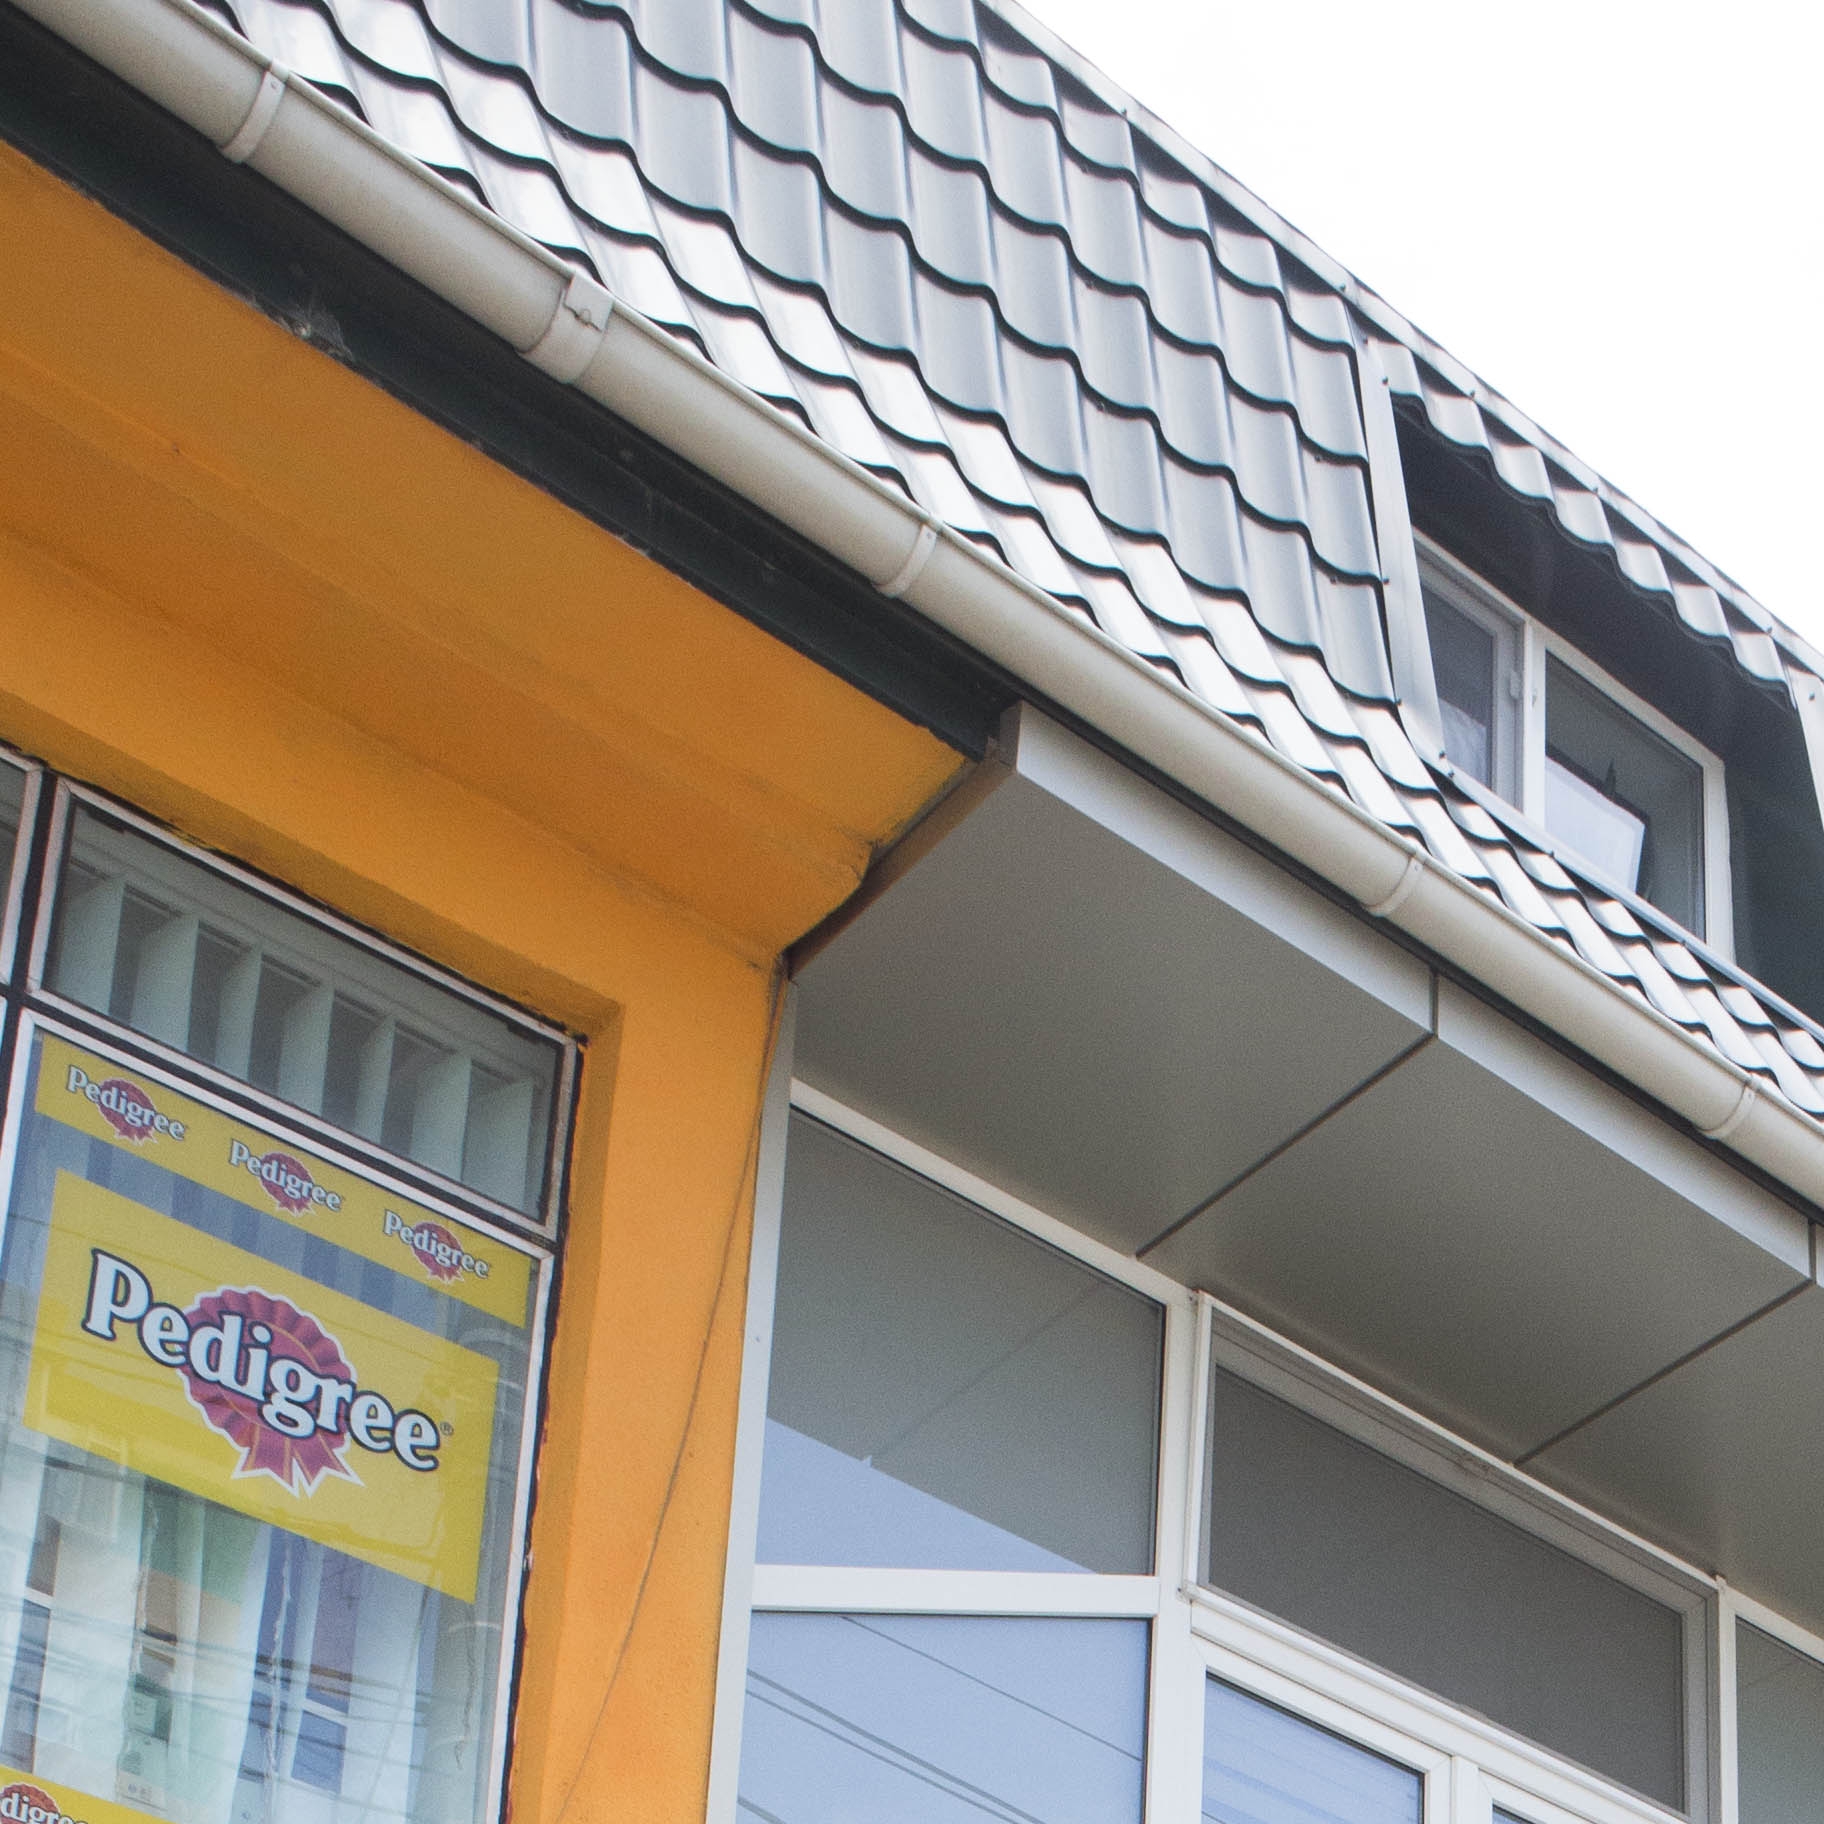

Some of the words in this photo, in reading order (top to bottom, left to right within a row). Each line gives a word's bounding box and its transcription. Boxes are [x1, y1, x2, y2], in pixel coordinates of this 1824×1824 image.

[67, 1065, 185, 1141] Pedigree
[229, 1139, 341, 1212] Pedigree
[383, 1209, 489, 1280] Pedigree
[82, 1248, 440, 1471] Pedigree
